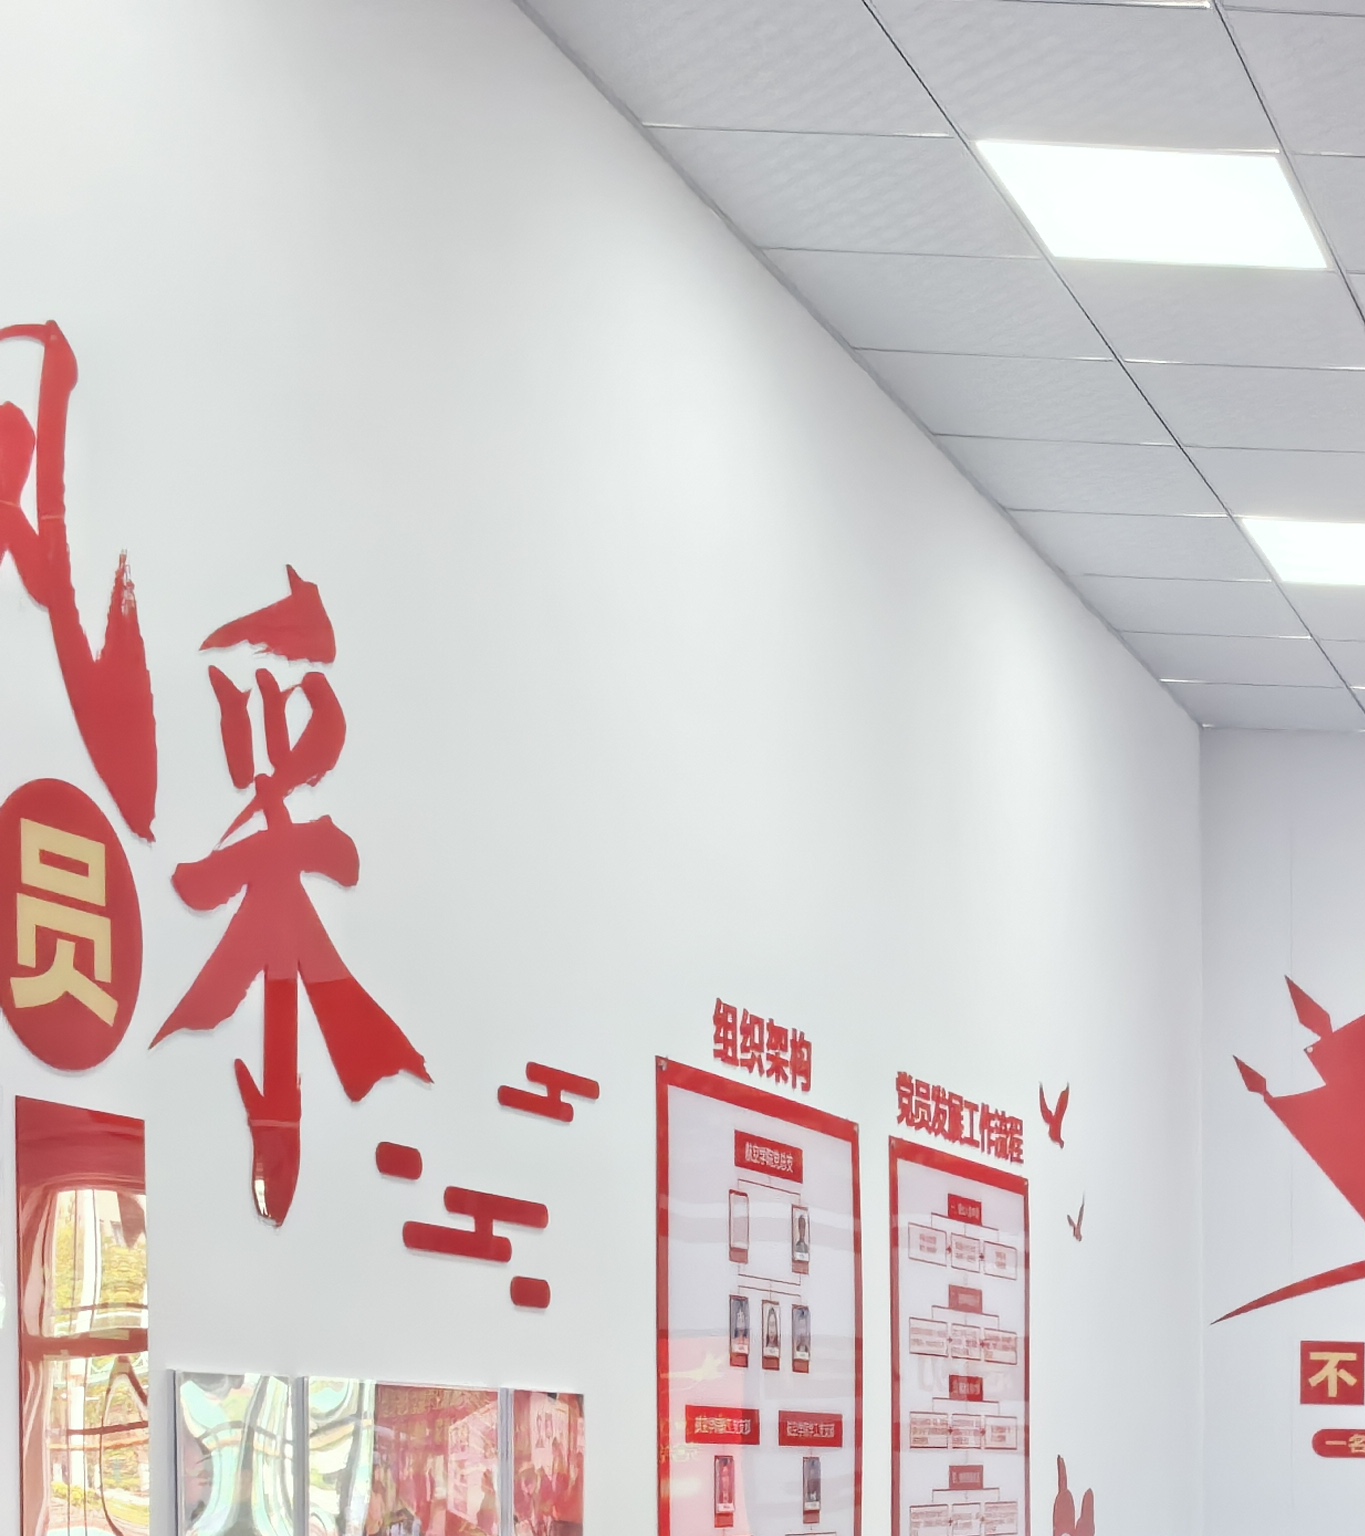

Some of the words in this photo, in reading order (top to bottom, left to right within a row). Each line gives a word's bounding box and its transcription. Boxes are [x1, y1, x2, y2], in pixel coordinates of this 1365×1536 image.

[10, 818, 118, 1027] 员
[713, 998, 812, 1091] 组织架构
[896, 1071, 1024, 1164] 党员发展工作流程
